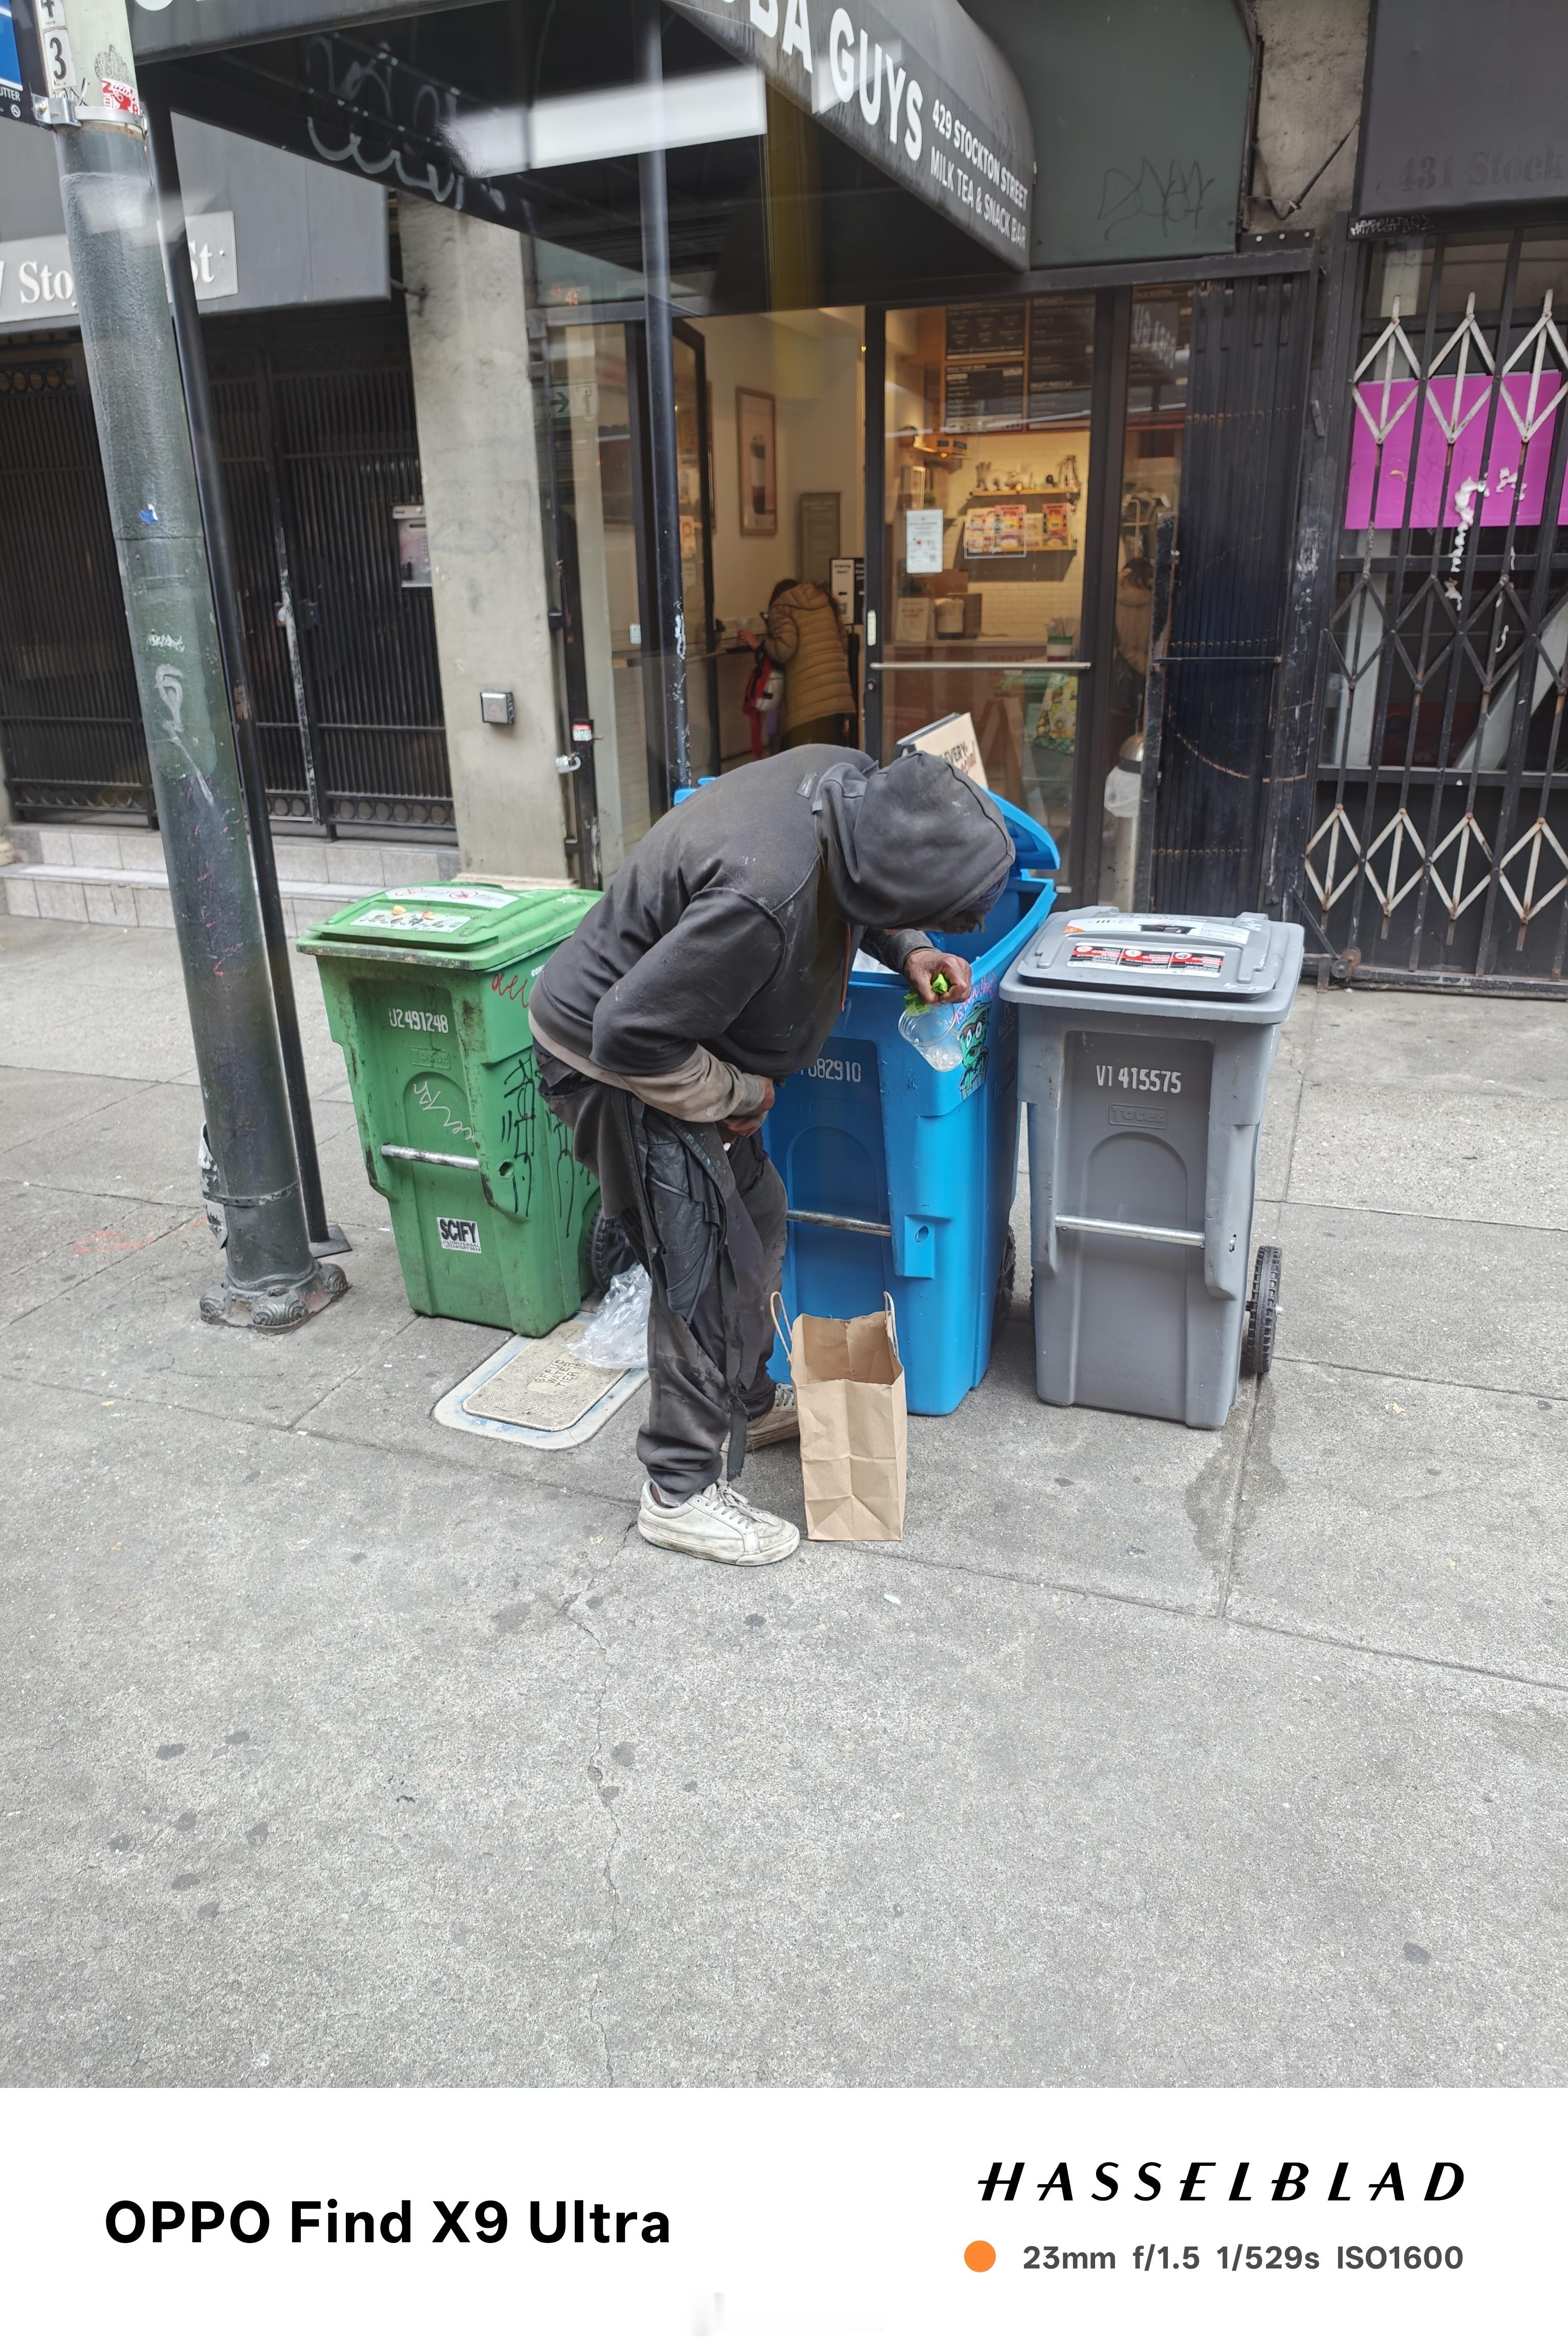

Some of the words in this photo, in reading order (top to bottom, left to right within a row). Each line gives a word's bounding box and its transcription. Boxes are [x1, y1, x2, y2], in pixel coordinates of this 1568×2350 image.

[50, 37, 67, 80] 3
[830, 8, 923, 161] GUYS
[932, 99, 952, 140] 429
[953, 119, 1000, 186] STOCKTON
[1001, 166, 1028, 211] STREET
[930, 146, 954, 192] MILK
[957, 168, 974, 208] TEA
[975, 186, 983, 215] &
[984, 193, 1011, 237] SNACK
[1011, 217, 1027, 250] BAR
[1118, 1067, 1182, 1093] 415575
[440, 1218, 476, 1243] SCIFY
[546, 1362, 575, 1383] WATER
